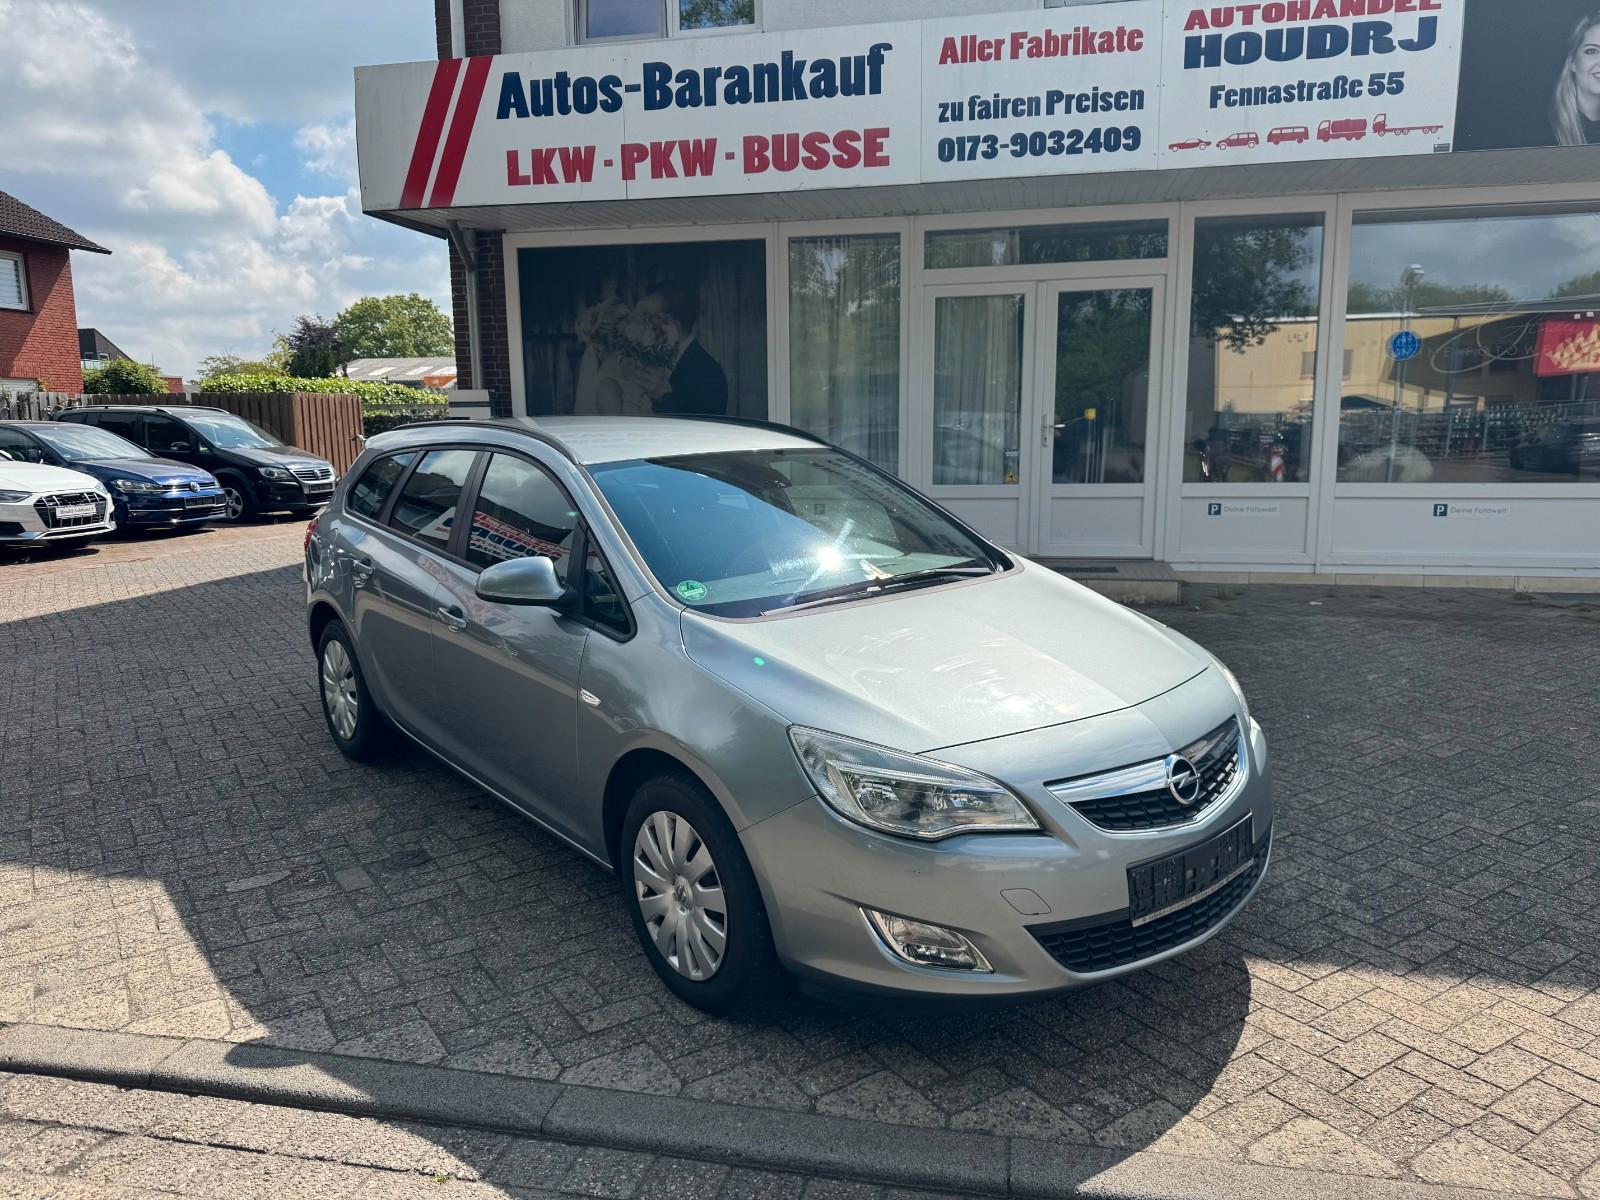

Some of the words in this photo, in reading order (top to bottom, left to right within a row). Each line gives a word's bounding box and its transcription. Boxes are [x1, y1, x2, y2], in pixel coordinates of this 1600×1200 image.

[938, 35, 1005, 64] Aller
[1010, 26, 1144, 60] Fabrikate
[1184, 16, 1438, 69] HOUDRJ
[496, 43, 893, 119] Autos-Barankauf
[1209, 75, 1363, 109] Fennastraße
[1367, 71, 1405, 97] 55
[938, 101, 963, 123] zu
[968, 93, 1041, 121] fairen
[1046, 86, 1145, 116] Preisen
[507, 145, 596, 186] LKW
[621, 138, 717, 180] PKW
[743, 127, 890, 174] BUSSE
[938, 126, 1141, 162] 0173-9032409
